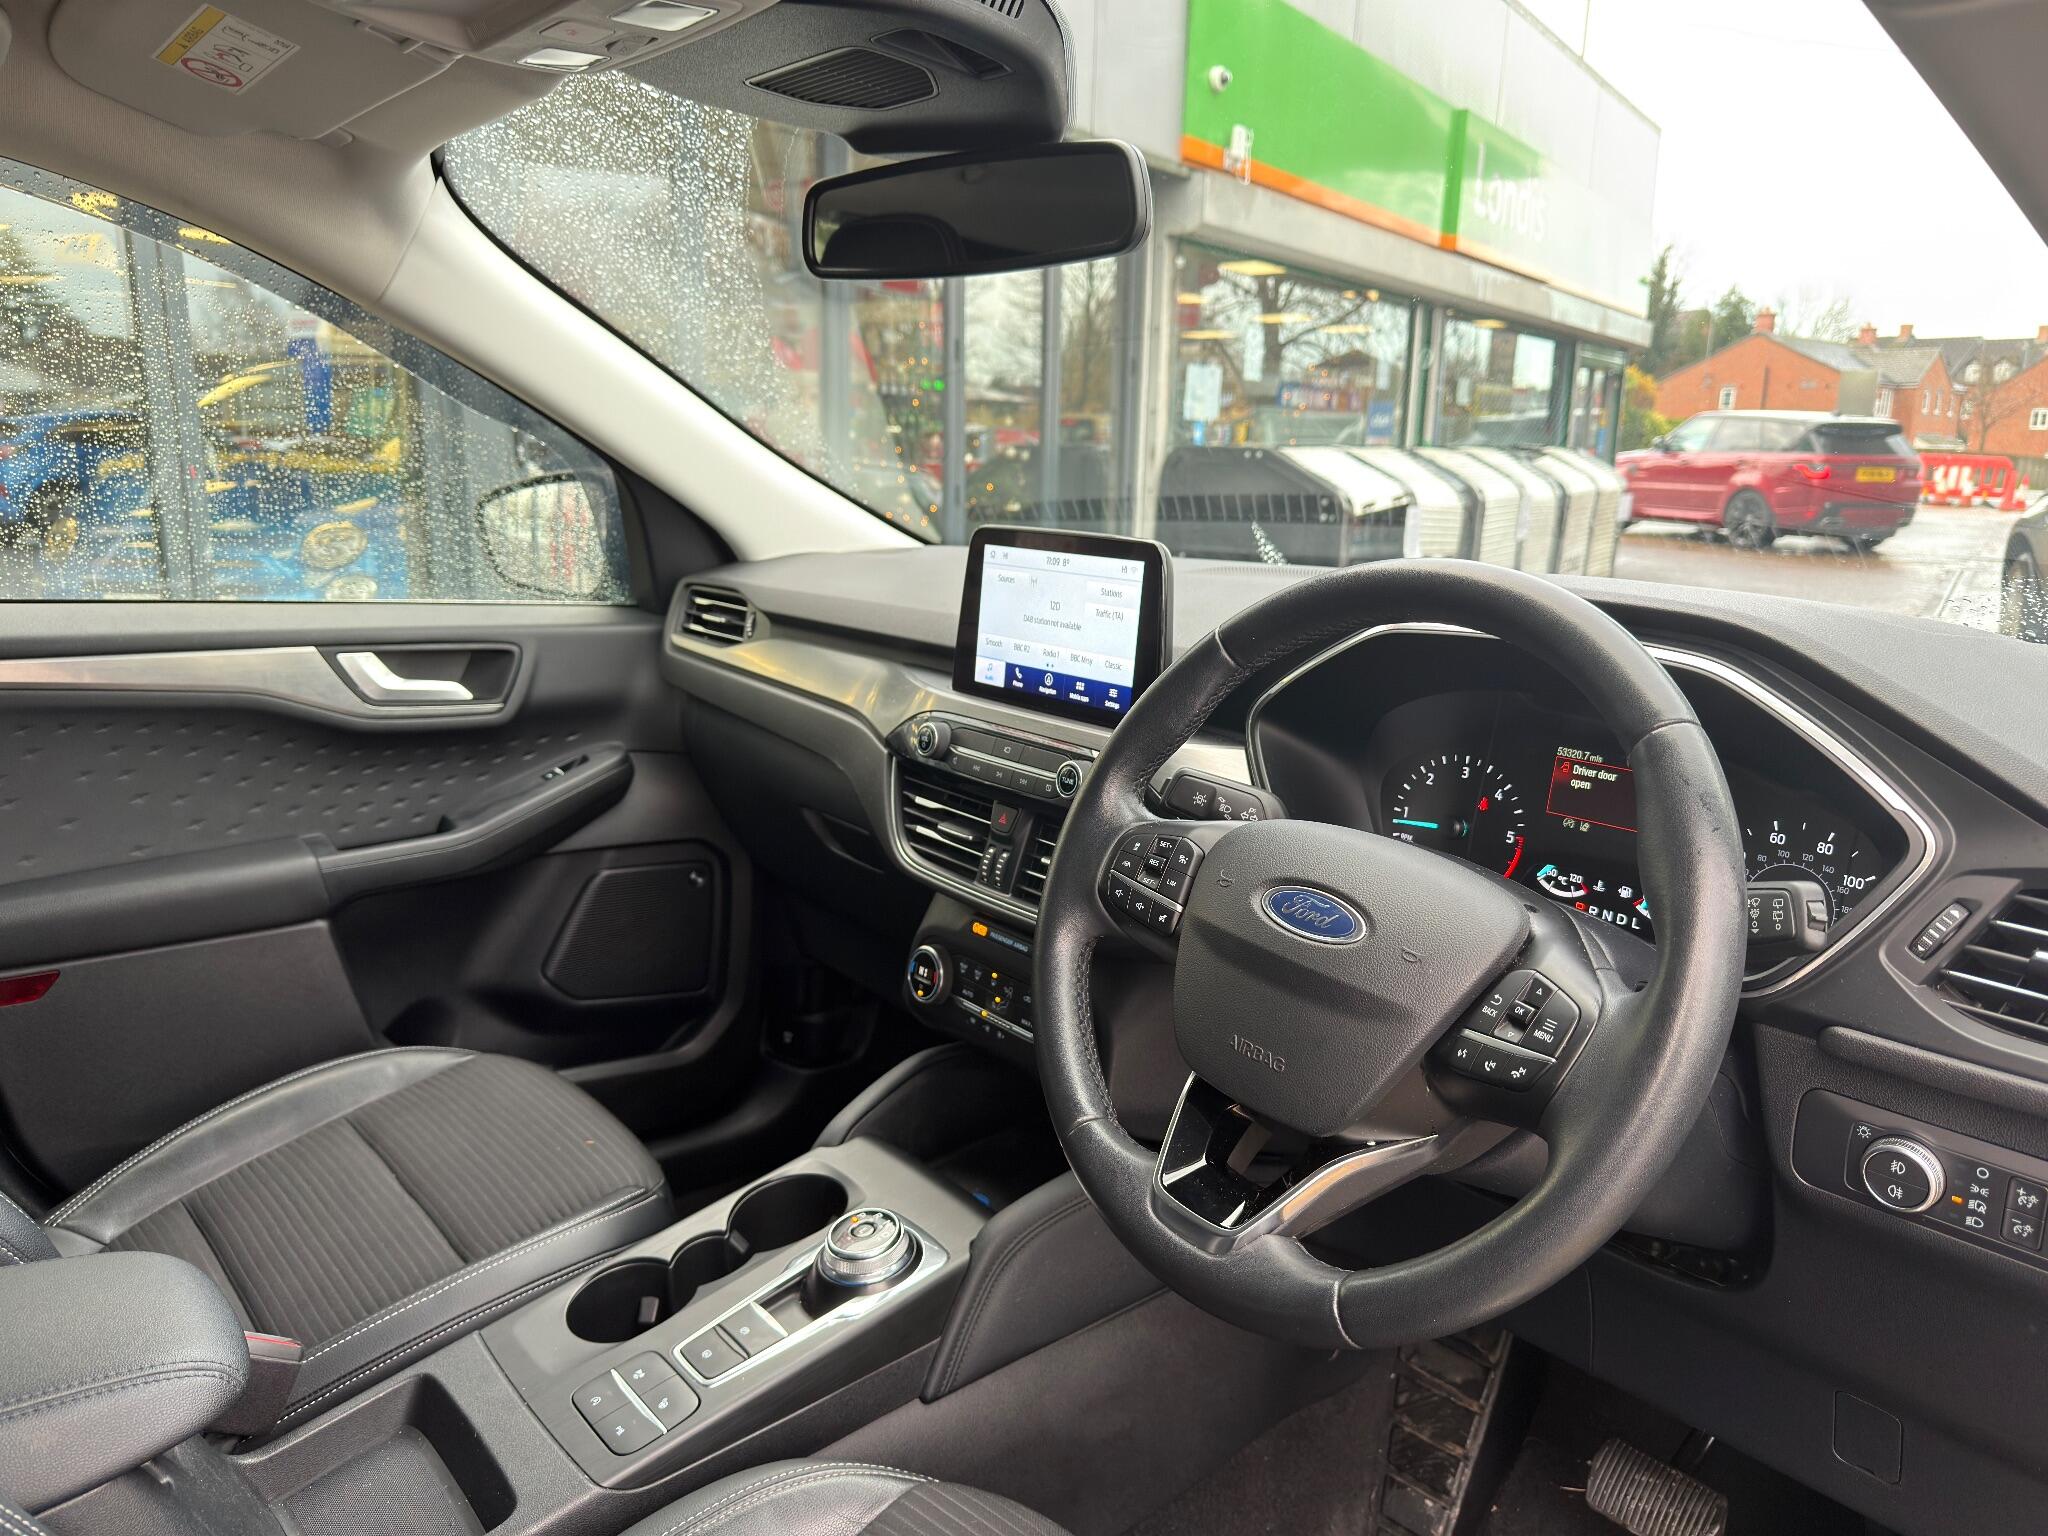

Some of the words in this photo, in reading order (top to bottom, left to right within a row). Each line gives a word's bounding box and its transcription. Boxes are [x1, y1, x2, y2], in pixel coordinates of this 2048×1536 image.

[1472, 143, 1547, 242] Londis
[998, 573, 1016, 584] Sources
[1100, 587, 1123, 598] Stations
[1095, 608, 1111, 618] Traffic
[1023, 614, 1034, 623] DAB
[1034, 617, 1051, 625] station
[1050, 619, 1060, 628] not
[1556, 746, 1590, 761] 53320.7
[1461, 766, 1470, 779] 3
[1572, 764, 1597, 778] Driver
[1598, 770, 1618, 782] door
[1425, 773, 1435, 786] 2
[1570, 779, 1591, 790] open
[1494, 788, 1503, 801] 4
[1403, 806, 1409, 818] 1
[1505, 830, 1515, 844] 5
[1769, 832, 1786, 845] 60
[1160, 840, 1172, 848] SET+
[1816, 842, 1834, 856] 80
[1757, 854, 1767, 862] 80
[1777, 849, 1790, 859] 100
[1802, 853, 1814, 862] 120
[1148, 858, 1160, 867] RES
[1822, 864, 1835, 875] 140
[1569, 872, 1583, 884] 120
[1843, 874, 1865, 890] 100
[1836, 885, 1850, 895] 160
[1282, 894, 1340, 928] Ford
[1588, 905, 1599, 915] R
[1601, 909, 1613, 922] N
[1615, 913, 1628, 926] D
[1631, 917, 1641, 930] L
[1482, 1005, 1498, 1018] BACK
[1514, 1006, 1525, 1016] OK
[1533, 1029, 1554, 1043] MENU
[1230, 1034, 1286, 1072] AIRBAG
